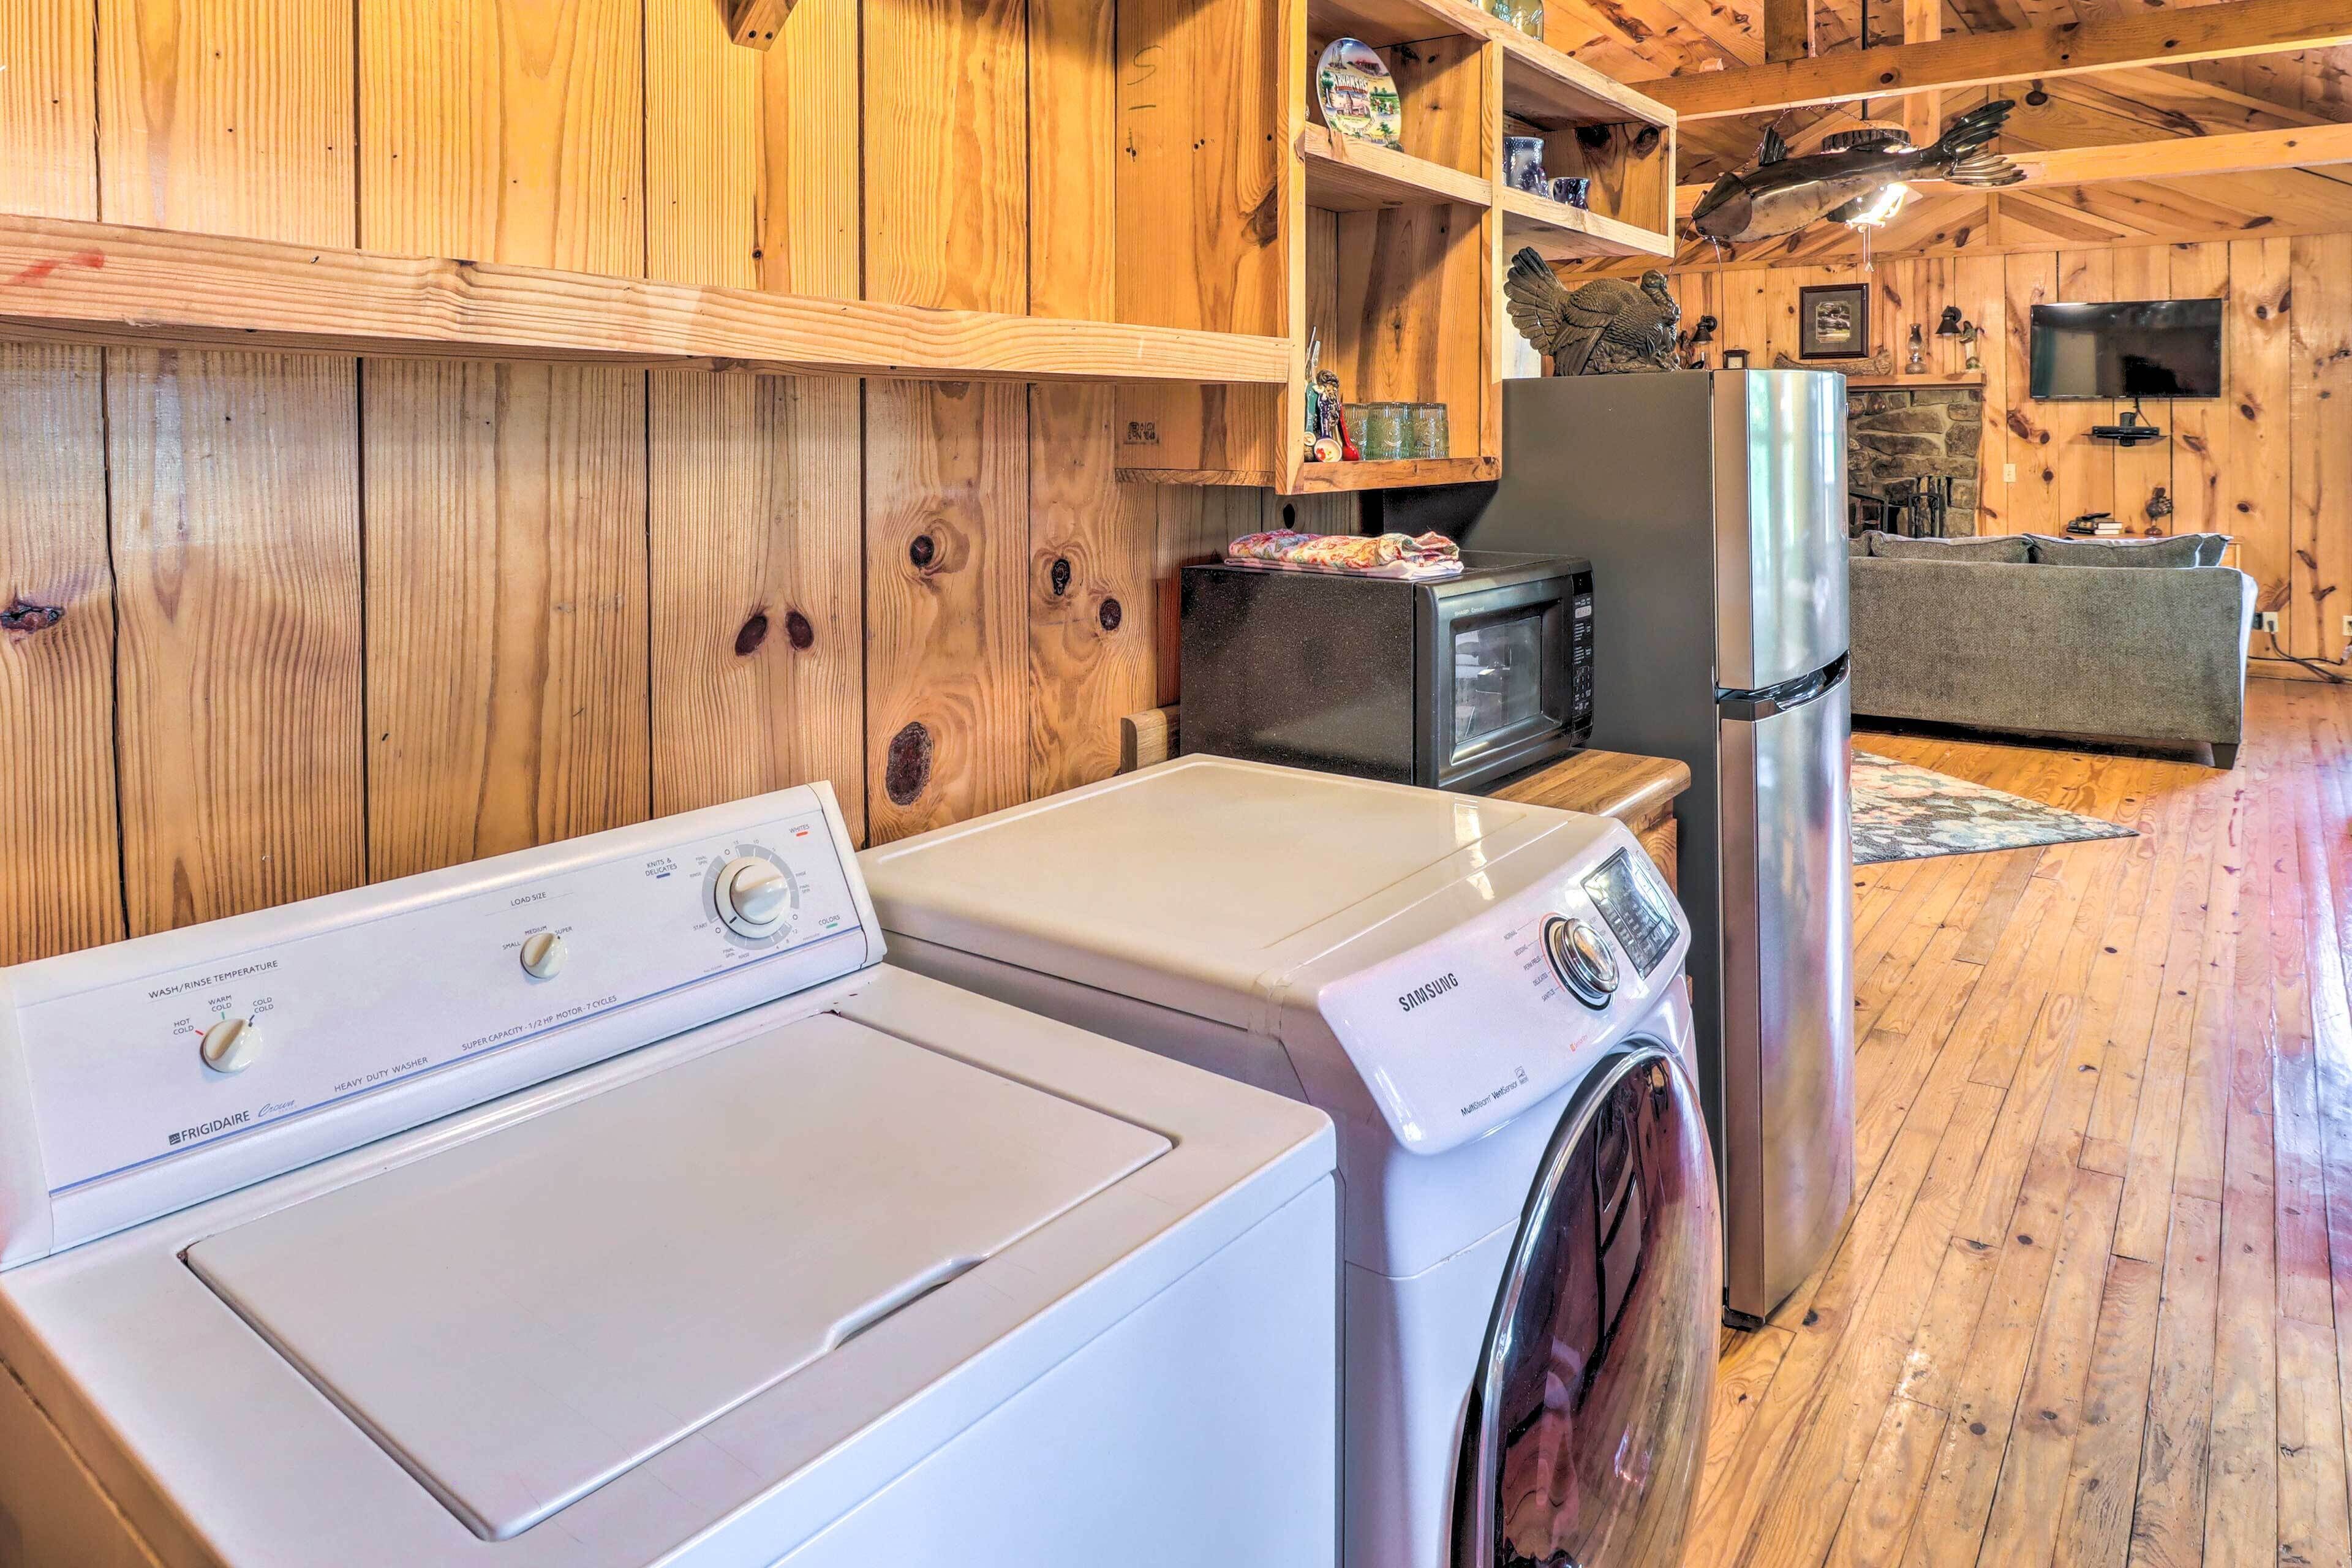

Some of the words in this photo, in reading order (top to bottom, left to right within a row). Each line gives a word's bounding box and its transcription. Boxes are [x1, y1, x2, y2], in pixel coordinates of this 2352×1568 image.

[1333, 74, 1368, 91] ARKANSAS
[789, 824, 810, 834] WHITES
[647, 859, 665, 868] KNITS
[645, 864, 678, 877] DELICATES
[510, 896, 530, 907] LOAD
[532, 892, 546, 901] SIZE
[819, 915, 840, 926] COLORS
[525, 925, 548, 936] MEDIUM
[555, 926, 573, 935] SUPER
[693, 922, 708, 931] START
[502, 941, 521, 951] SMALL
[148, 977, 213, 999] WASH/RINSE
[213, 960, 279, 982] TEMPERATURE
[1398, 973, 1458, 1012] SAMSUNG
[208, 995, 232, 1006] WARM
[253, 997, 273, 1007] COLD
[211, 1002, 232, 1012] COLD
[254, 1003, 274, 1014] COLD
[174, 1018, 191, 1028] HOT
[462, 1037, 488, 1051] SUPER
[489, 1025, 523, 1042] CAPACITY
[529, 1019, 543, 1030] 1/2
[543, 1016, 554, 1024] HP
[556, 1006, 583, 1020] MOTOR
[592, 995, 617, 1008] CYCLES
[173, 1025, 194, 1036] COLD
[334, 1077, 363, 1093] HEAVY
[366, 1069, 389, 1083] DUTY
[392, 1057, 428, 1073] WASHER
[1491, 1080, 1518, 1099] VentSensor
[181, 1110, 251, 1142] FRIGIDAIRE
[258, 1099, 295, 1117] Crown
